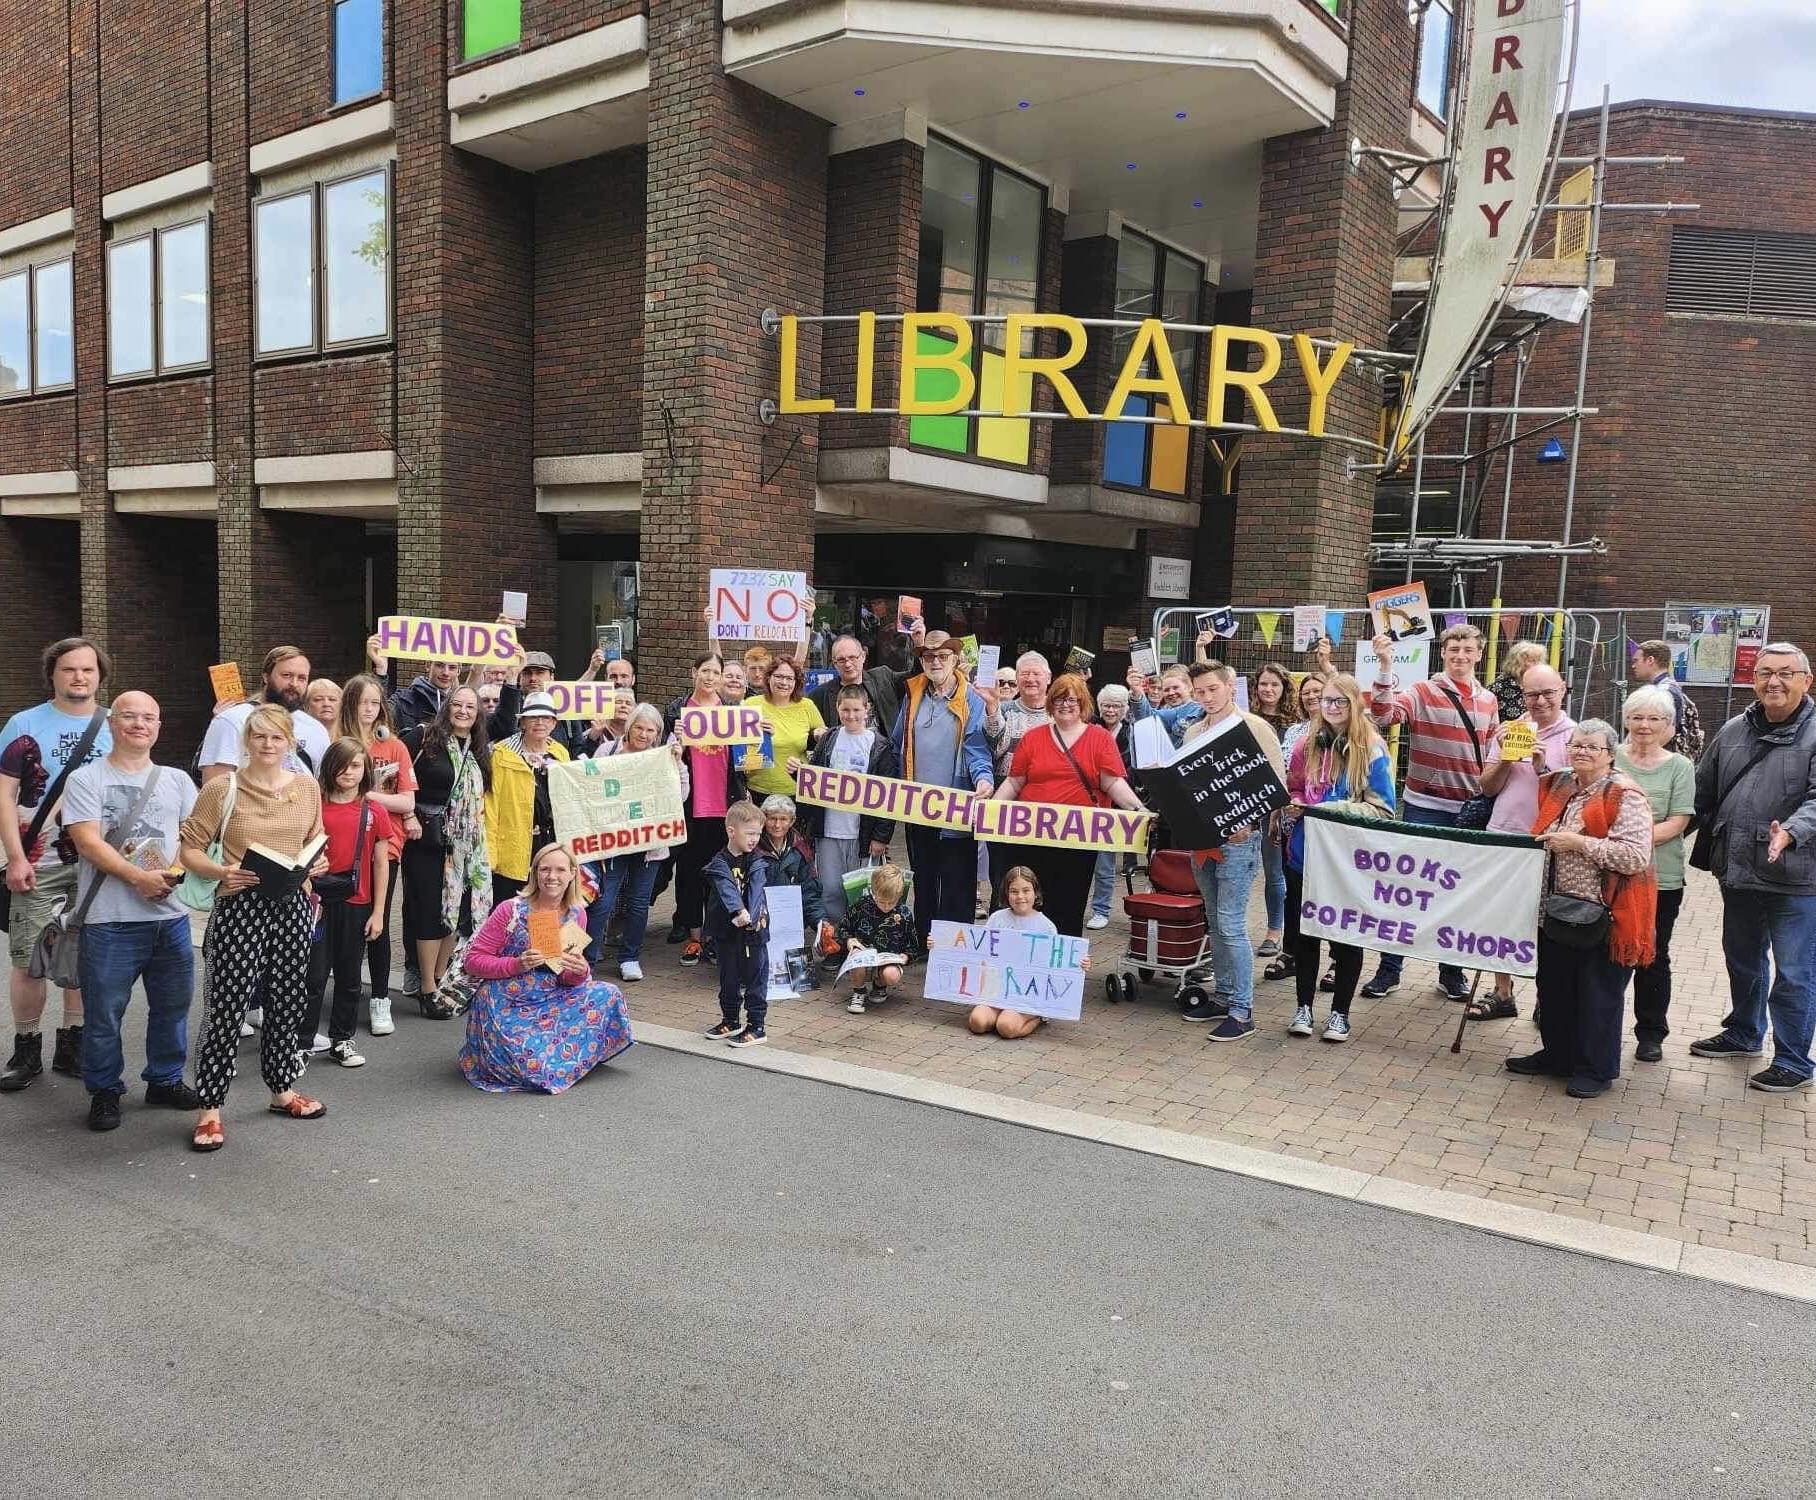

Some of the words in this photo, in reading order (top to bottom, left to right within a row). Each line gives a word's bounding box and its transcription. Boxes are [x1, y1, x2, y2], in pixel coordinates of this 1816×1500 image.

[779, 311, 1354, 436] LIBRARY
[768, 573, 796, 587] SAY
[716, 587, 799, 622] NO
[381, 620, 515, 659] HANDS
[545, 683, 614, 715] OFF
[682, 709, 762, 740] OUR
[1178, 751, 1214, 776] Every
[1193, 789, 1209, 802] in
[1210, 773, 1232, 792] the
[1232, 753, 1268, 778] Book
[1212, 748, 1247, 772] Trick
[798, 767, 975, 826] REDDITCH
[975, 800, 1145, 845] LIBRARY
[1213, 784, 1277, 827] Redditch
[1224, 789, 1241, 804] by
[1220, 801, 1272, 838] Council
[571, 820, 685, 856] REDDITCH
[1353, 849, 1461, 890] BOOKS
[1373, 879, 1435, 911] NOT
[1301, 900, 1417, 945] COFFEE
[1436, 926, 1536, 963] SHOPS
[1021, 933, 1082, 969] THE
